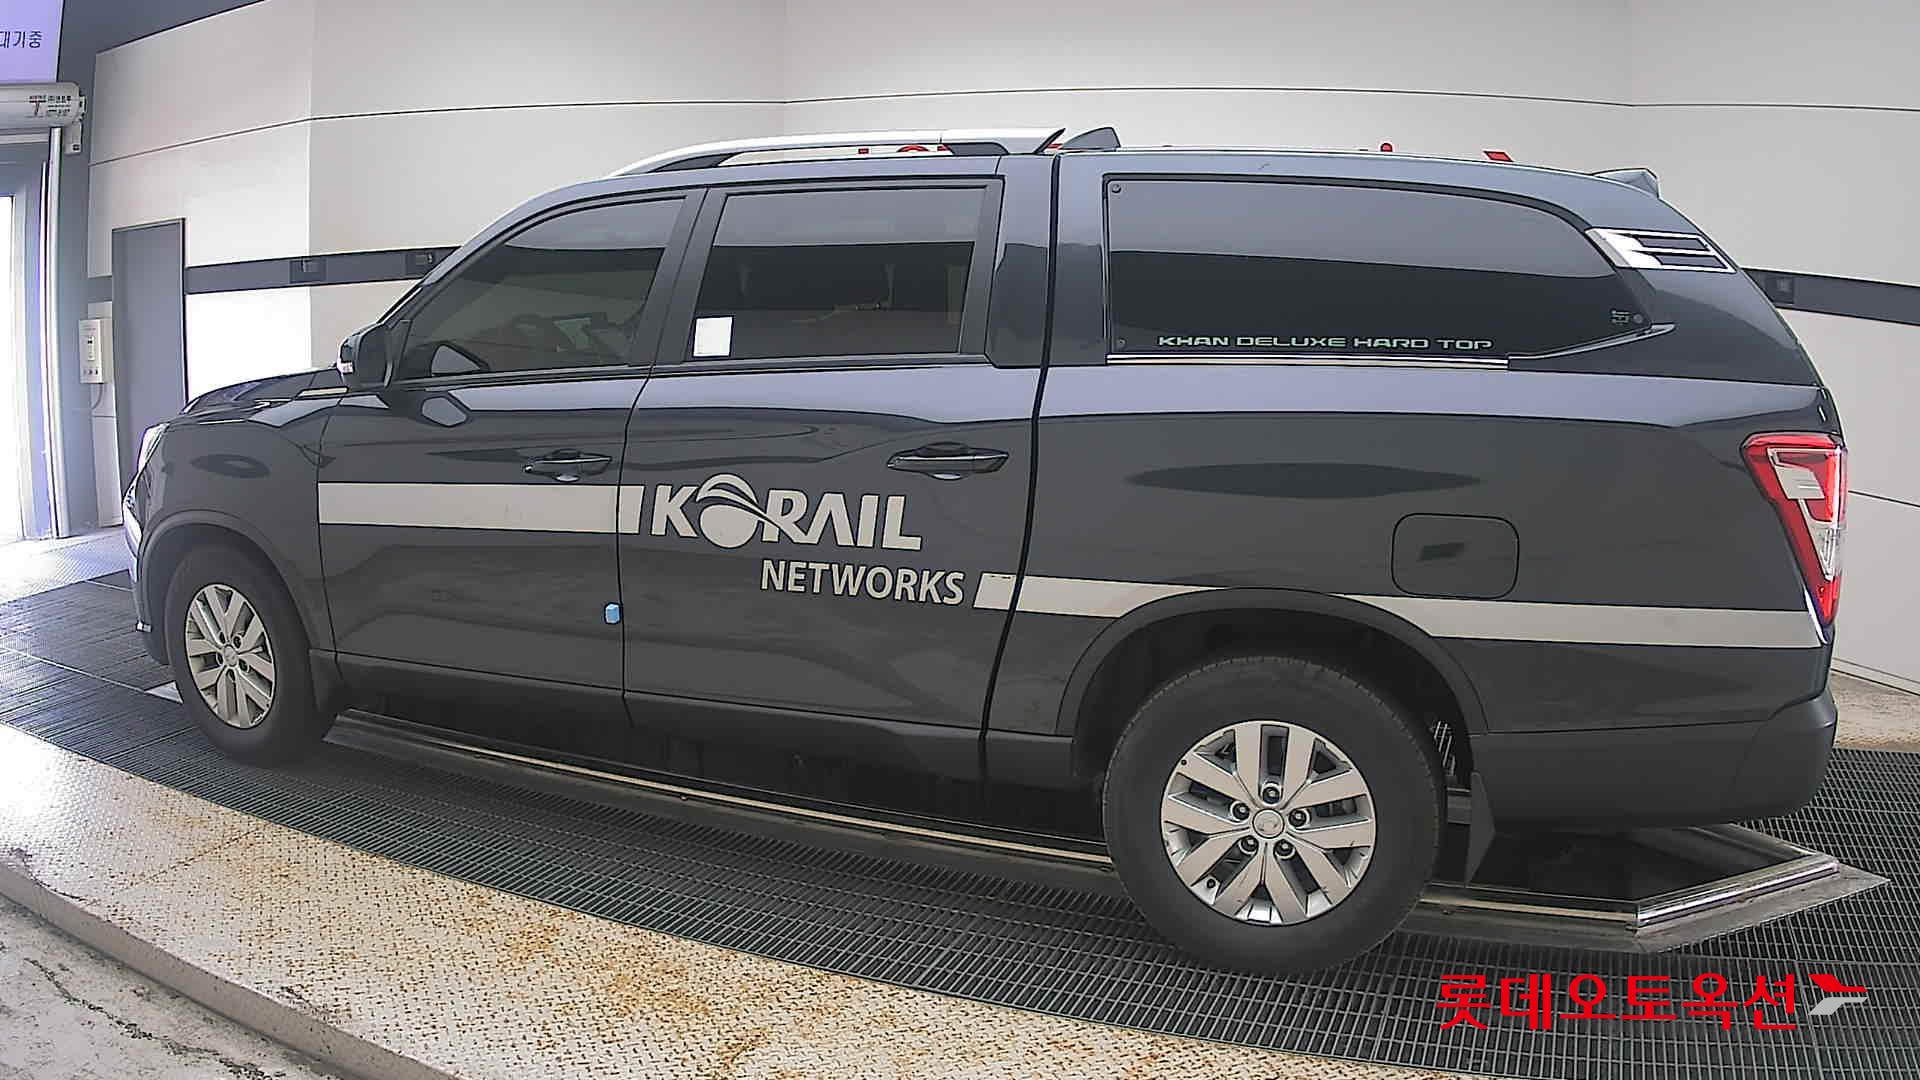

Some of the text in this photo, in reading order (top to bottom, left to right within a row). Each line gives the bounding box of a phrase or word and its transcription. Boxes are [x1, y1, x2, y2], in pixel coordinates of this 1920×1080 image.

[0, 30, 43, 49] 대기중
[1158, 335, 1493, 350] KHAN DELUXE HARD TOP
[651, 473, 923, 550] KORAIL
[760, 559, 964, 606] NETWORKS
